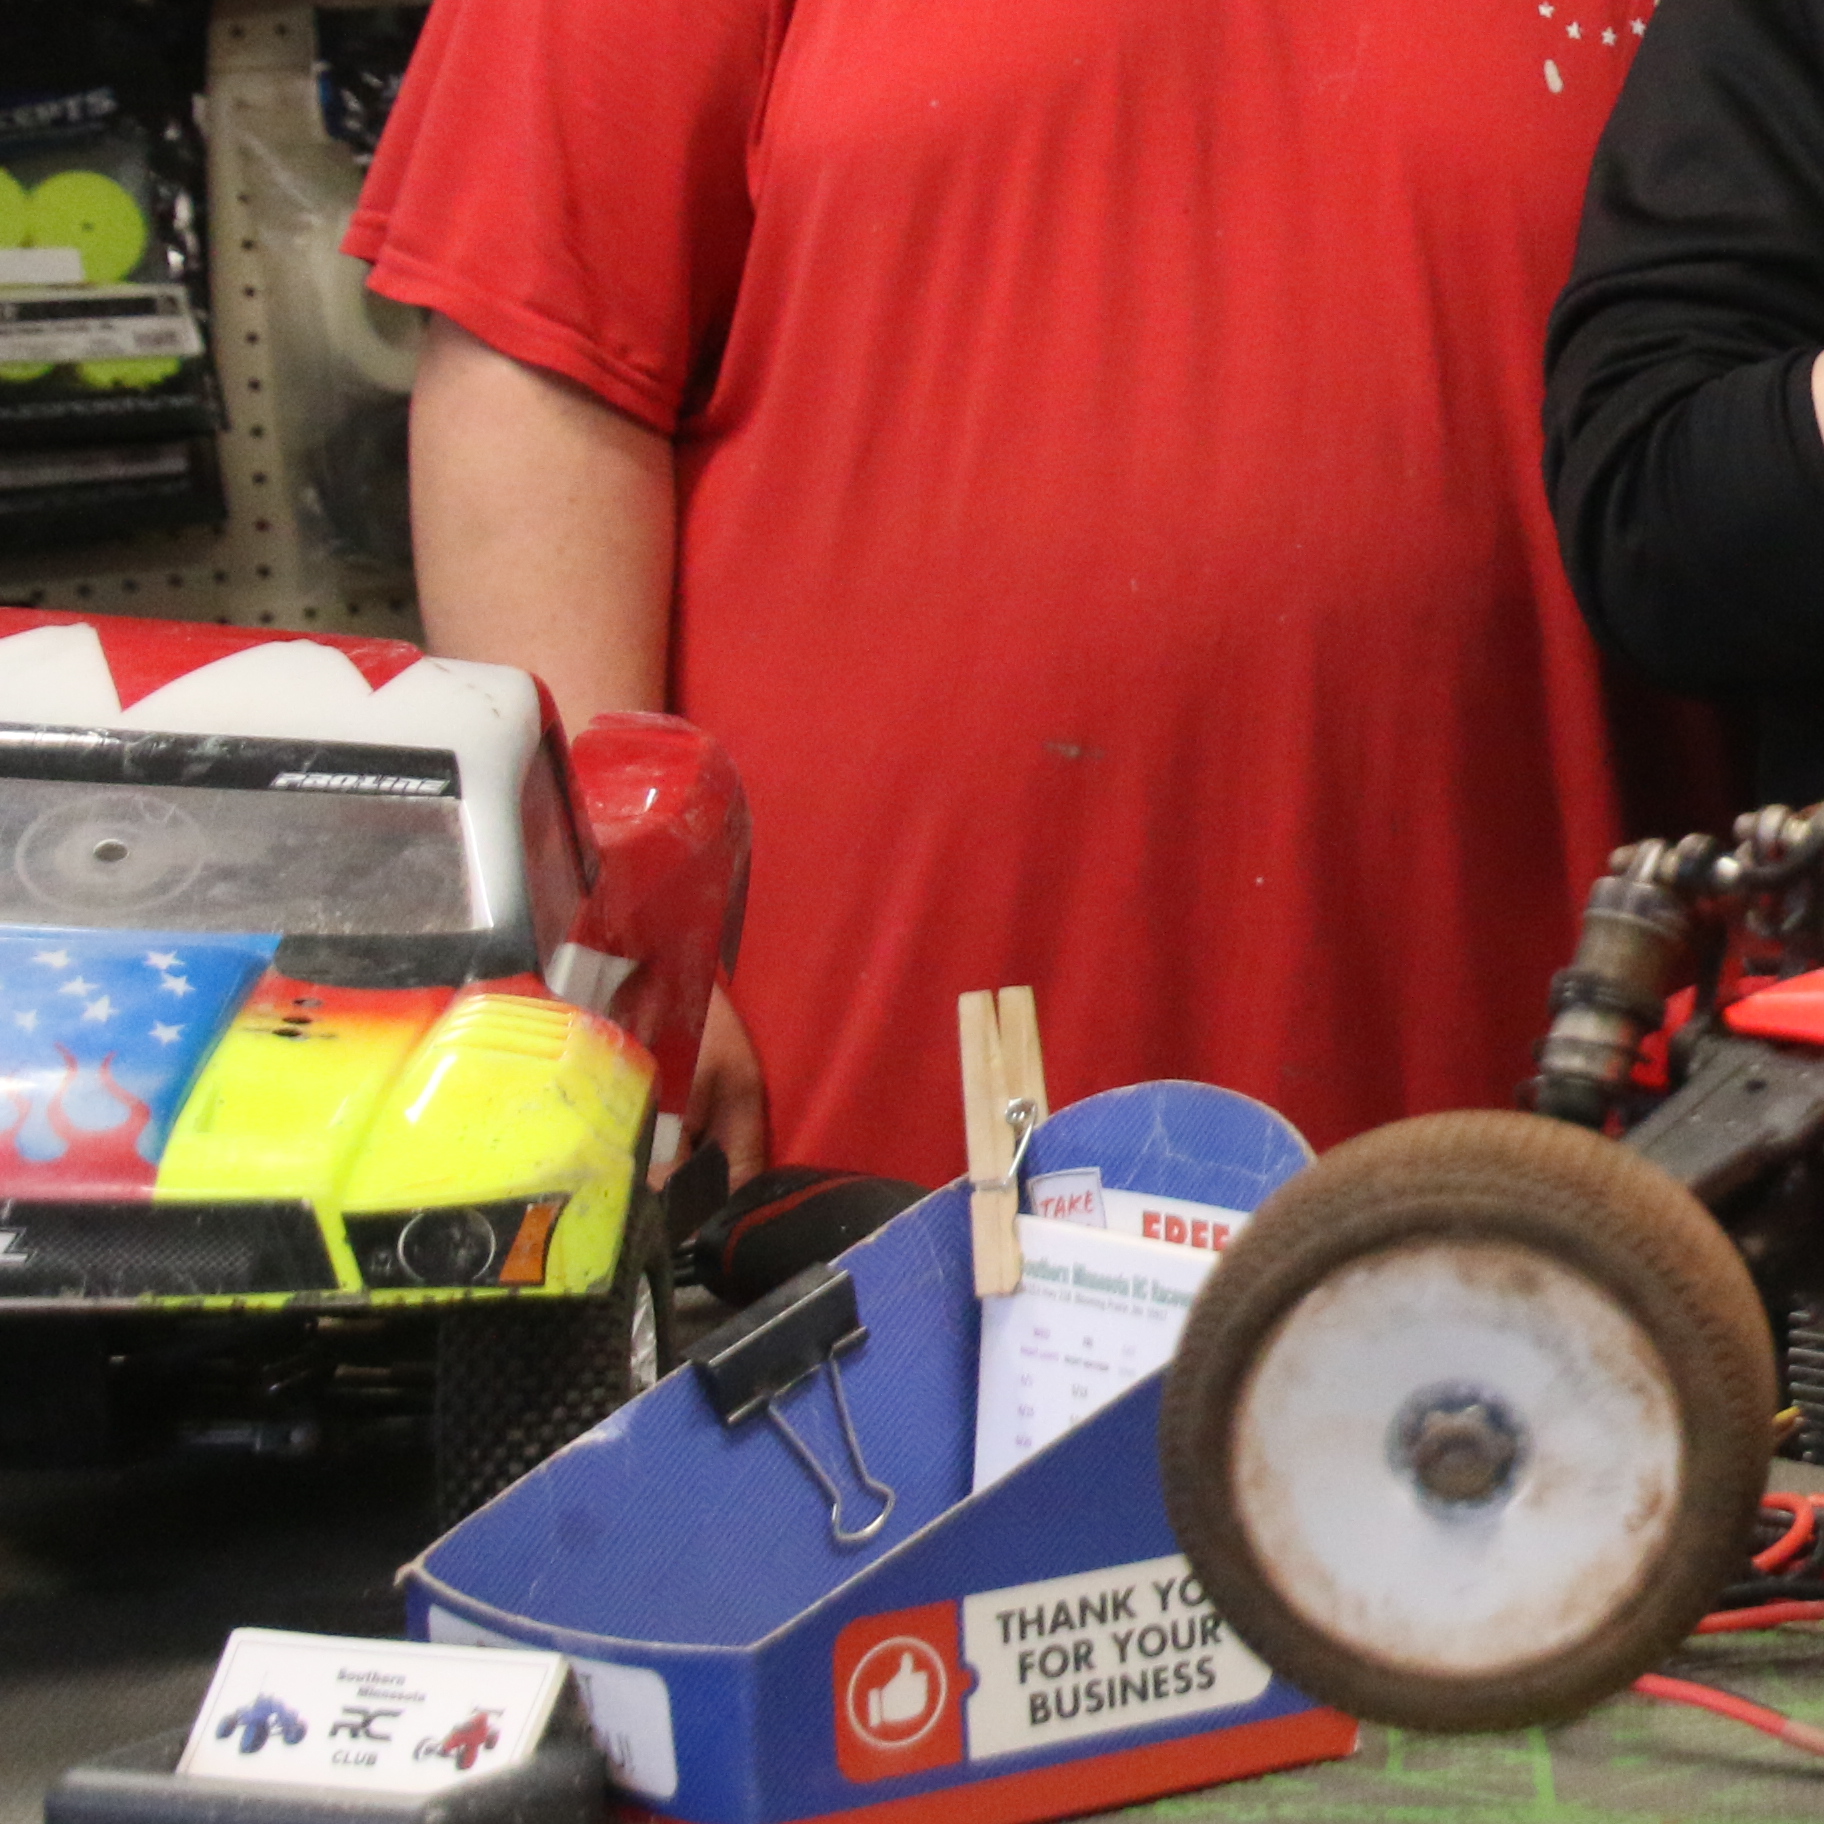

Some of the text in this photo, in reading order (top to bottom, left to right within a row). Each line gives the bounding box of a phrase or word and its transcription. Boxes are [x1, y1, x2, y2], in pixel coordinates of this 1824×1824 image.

[1040, 1190, 1095, 1219] TAKE
[1025, 1257, 1070, 1283] outhern
[996, 1575, 1204, 1644] THANK YO
[1018, 1610, 1223, 1684] FOR YOUR
[337, 1667, 407, 1686] Southern
[1029, 1655, 1217, 1726] BUSINESS
[357, 1685, 427, 1702] Minnesota
[328, 1705, 405, 1742] RC
[331, 1749, 379, 1766] CLUB
